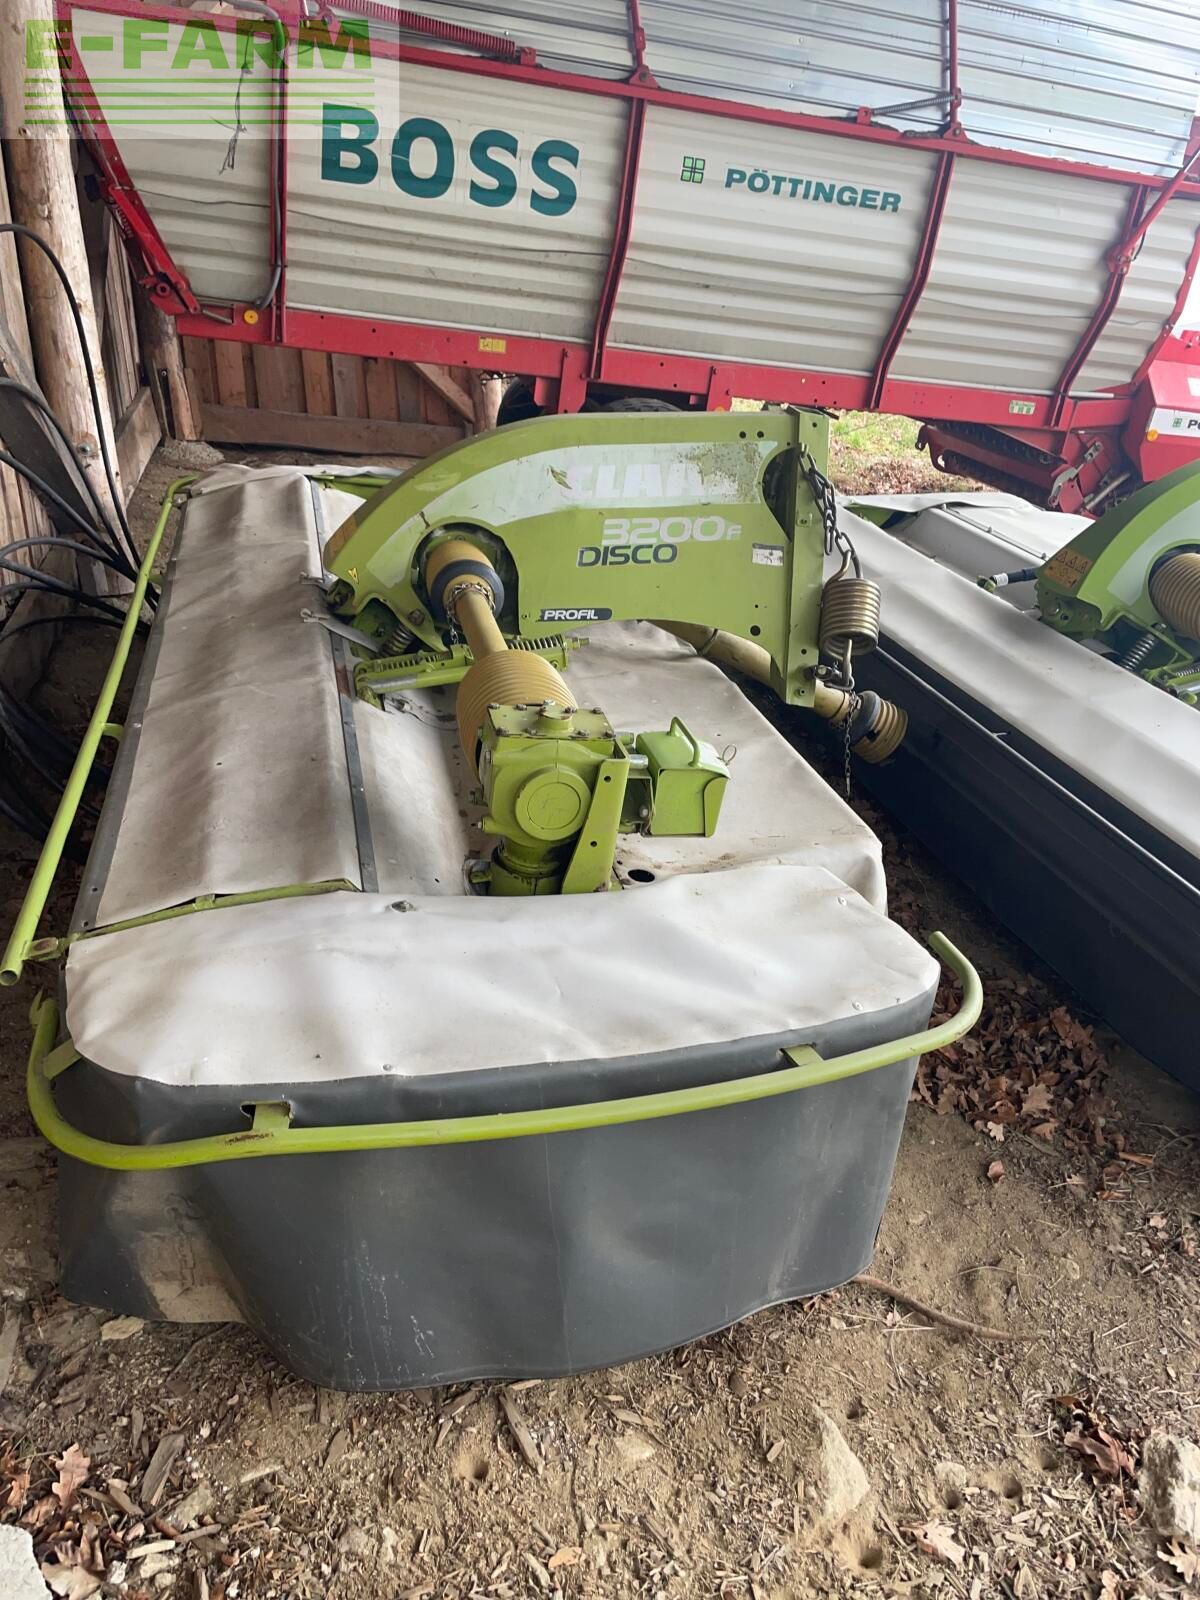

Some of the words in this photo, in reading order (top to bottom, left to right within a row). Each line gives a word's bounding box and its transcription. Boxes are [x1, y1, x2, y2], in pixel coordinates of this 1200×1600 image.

[321, 102, 580, 217] BOSS
[725, 168, 901, 213] PÖTTINGER
[1187, 419, 1200, 430] P
[577, 543, 678, 567] DISCO
[543, 609, 599, 621] PROFIL
